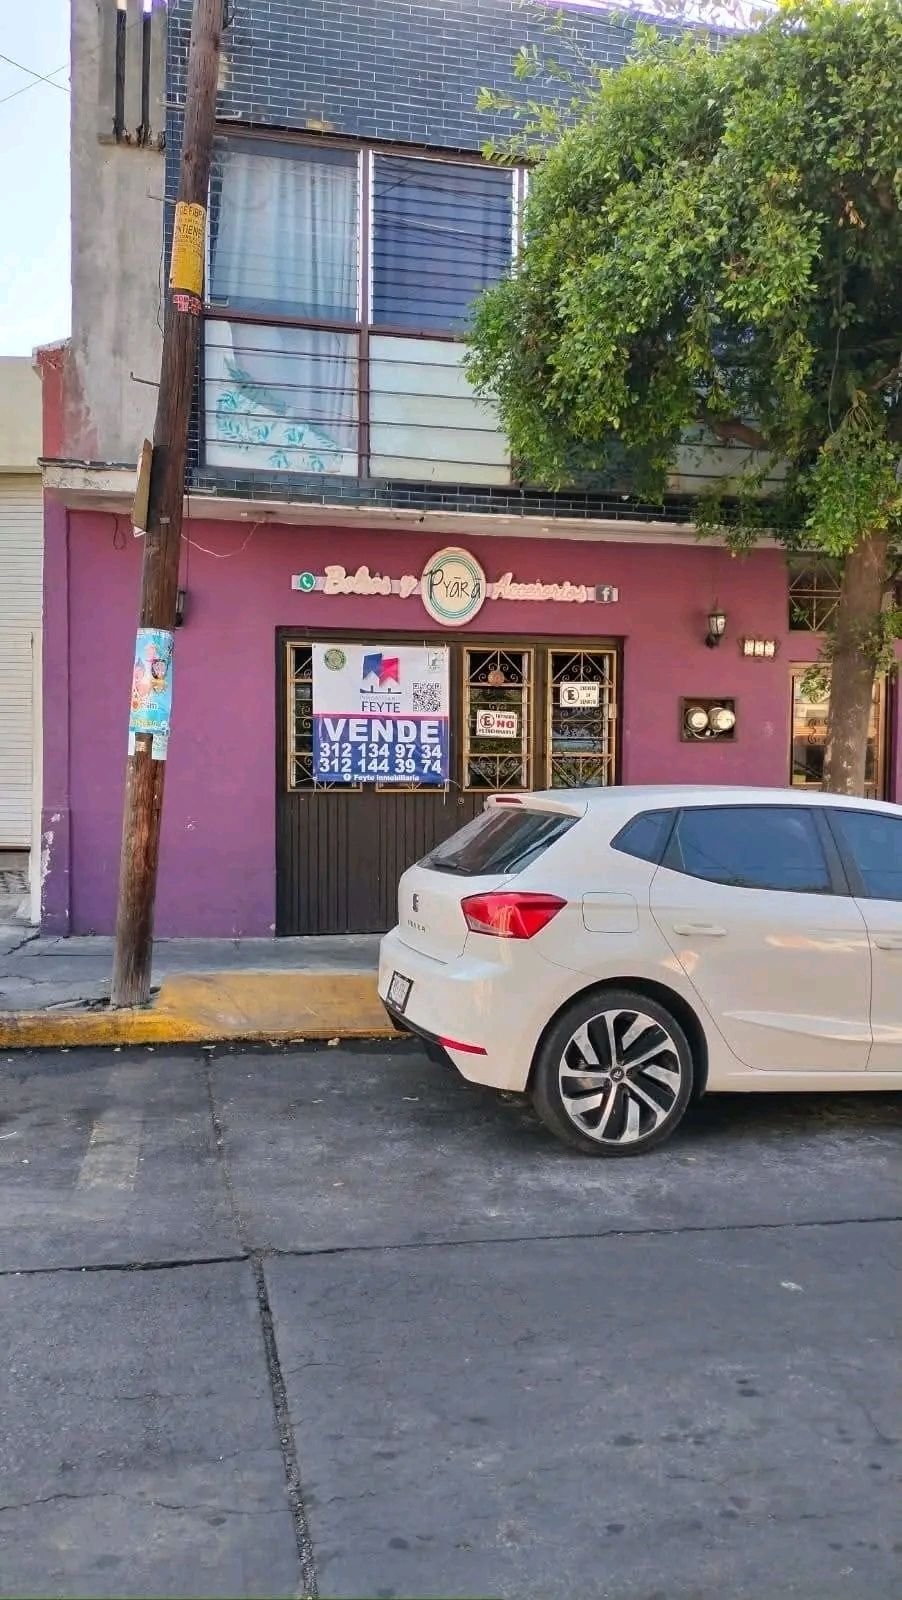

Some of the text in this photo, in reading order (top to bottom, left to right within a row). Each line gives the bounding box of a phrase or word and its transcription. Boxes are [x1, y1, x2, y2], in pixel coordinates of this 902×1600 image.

[361, 701, 401, 713] FEYTE
[323, 718, 440, 743] VENDE
[496, 720, 515, 729] NO
[319, 742, 442, 760] 312 134 97 34
[319, 757, 442, 774] 312 144 39 74
